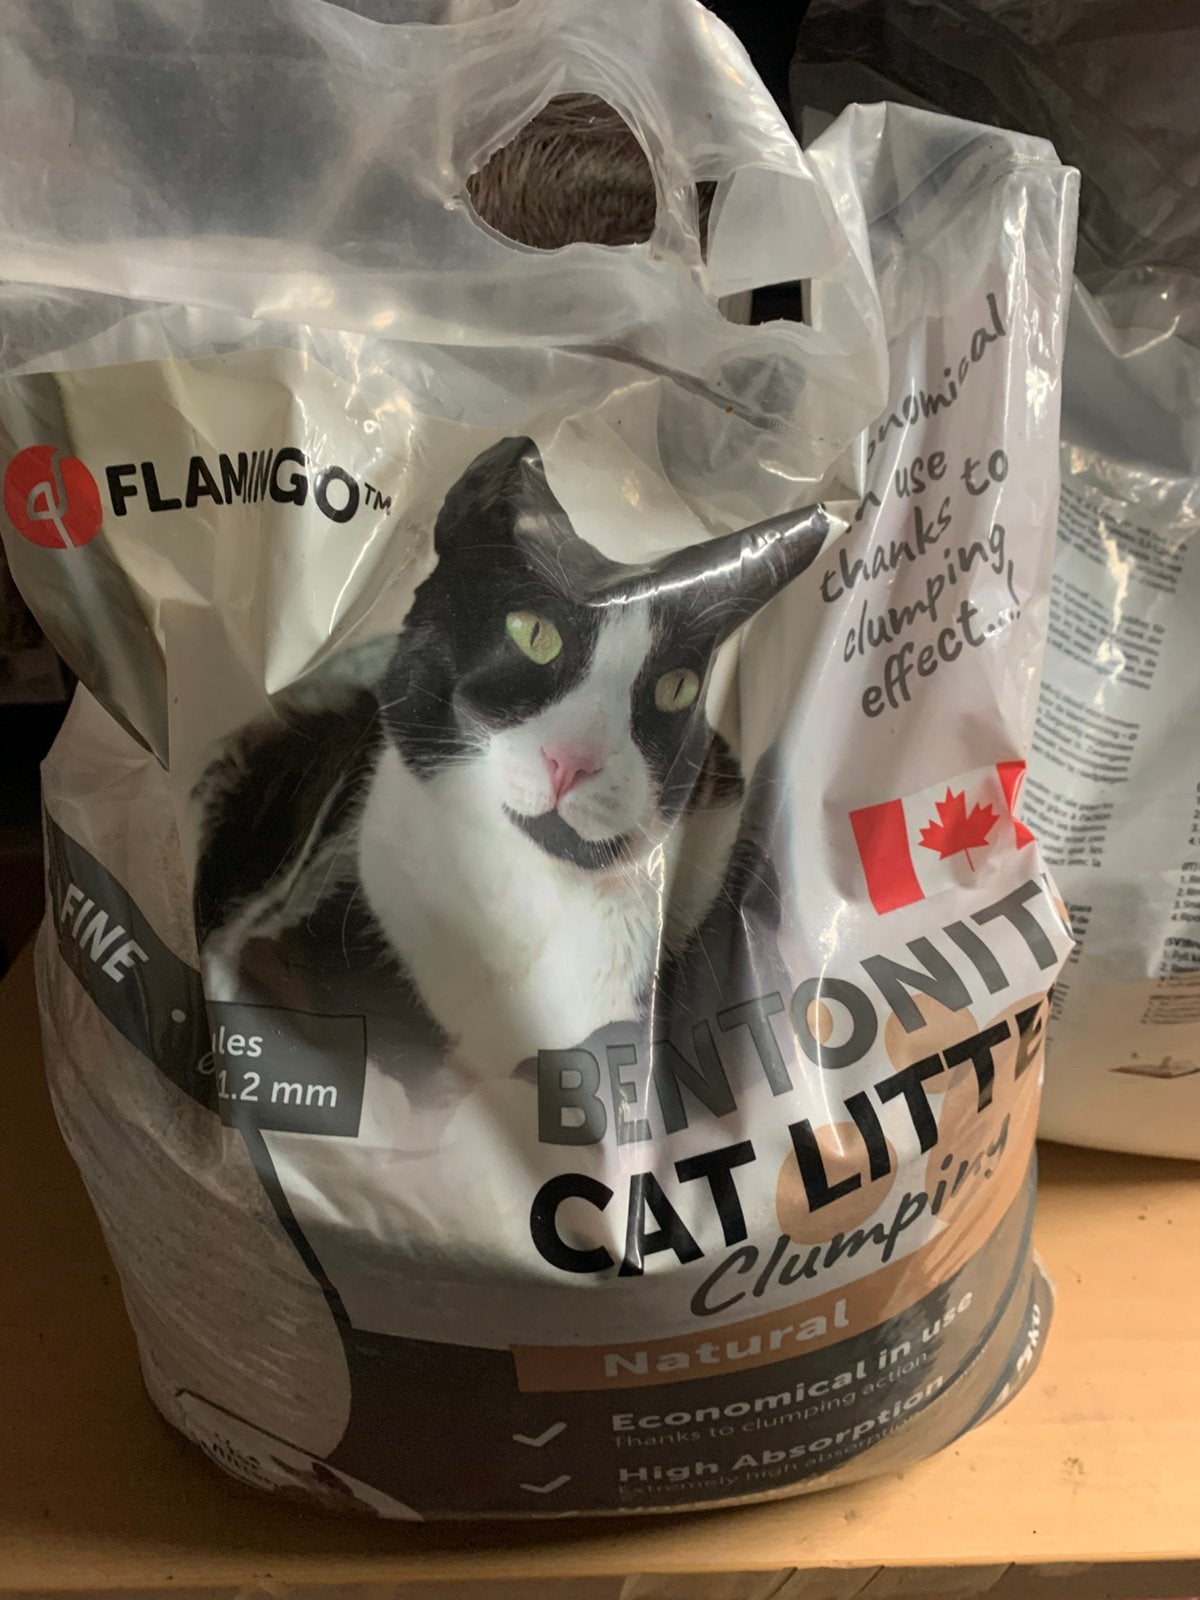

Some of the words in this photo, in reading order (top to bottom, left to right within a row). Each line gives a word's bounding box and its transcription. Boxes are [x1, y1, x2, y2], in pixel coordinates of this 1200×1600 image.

[820, 497, 952, 604] thanks
[960, 448, 1009, 498] to
[895, 450, 947, 498] use
[843, 523, 1006, 662] clumping
[60, 883, 149, 983] FINE
[536, 876, 1060, 1146] BENTONIT
[271, 1081, 338, 1108] mm
[529, 1139, 757, 1278] CAT
[603, 1298, 851, 1379] Natural
[611, 1360, 868, 1433] Economical
[878, 1341, 912, 1371] in
[921, 1291, 974, 1344] use
[611, 1430, 702, 1448] Thanks
[709, 1424, 735, 1438] to
[742, 1391, 856, 1433] clumping
[863, 1352, 928, 1396] action
[618, 1461, 719, 1483] High
[731, 1374, 945, 1472] Absorption
